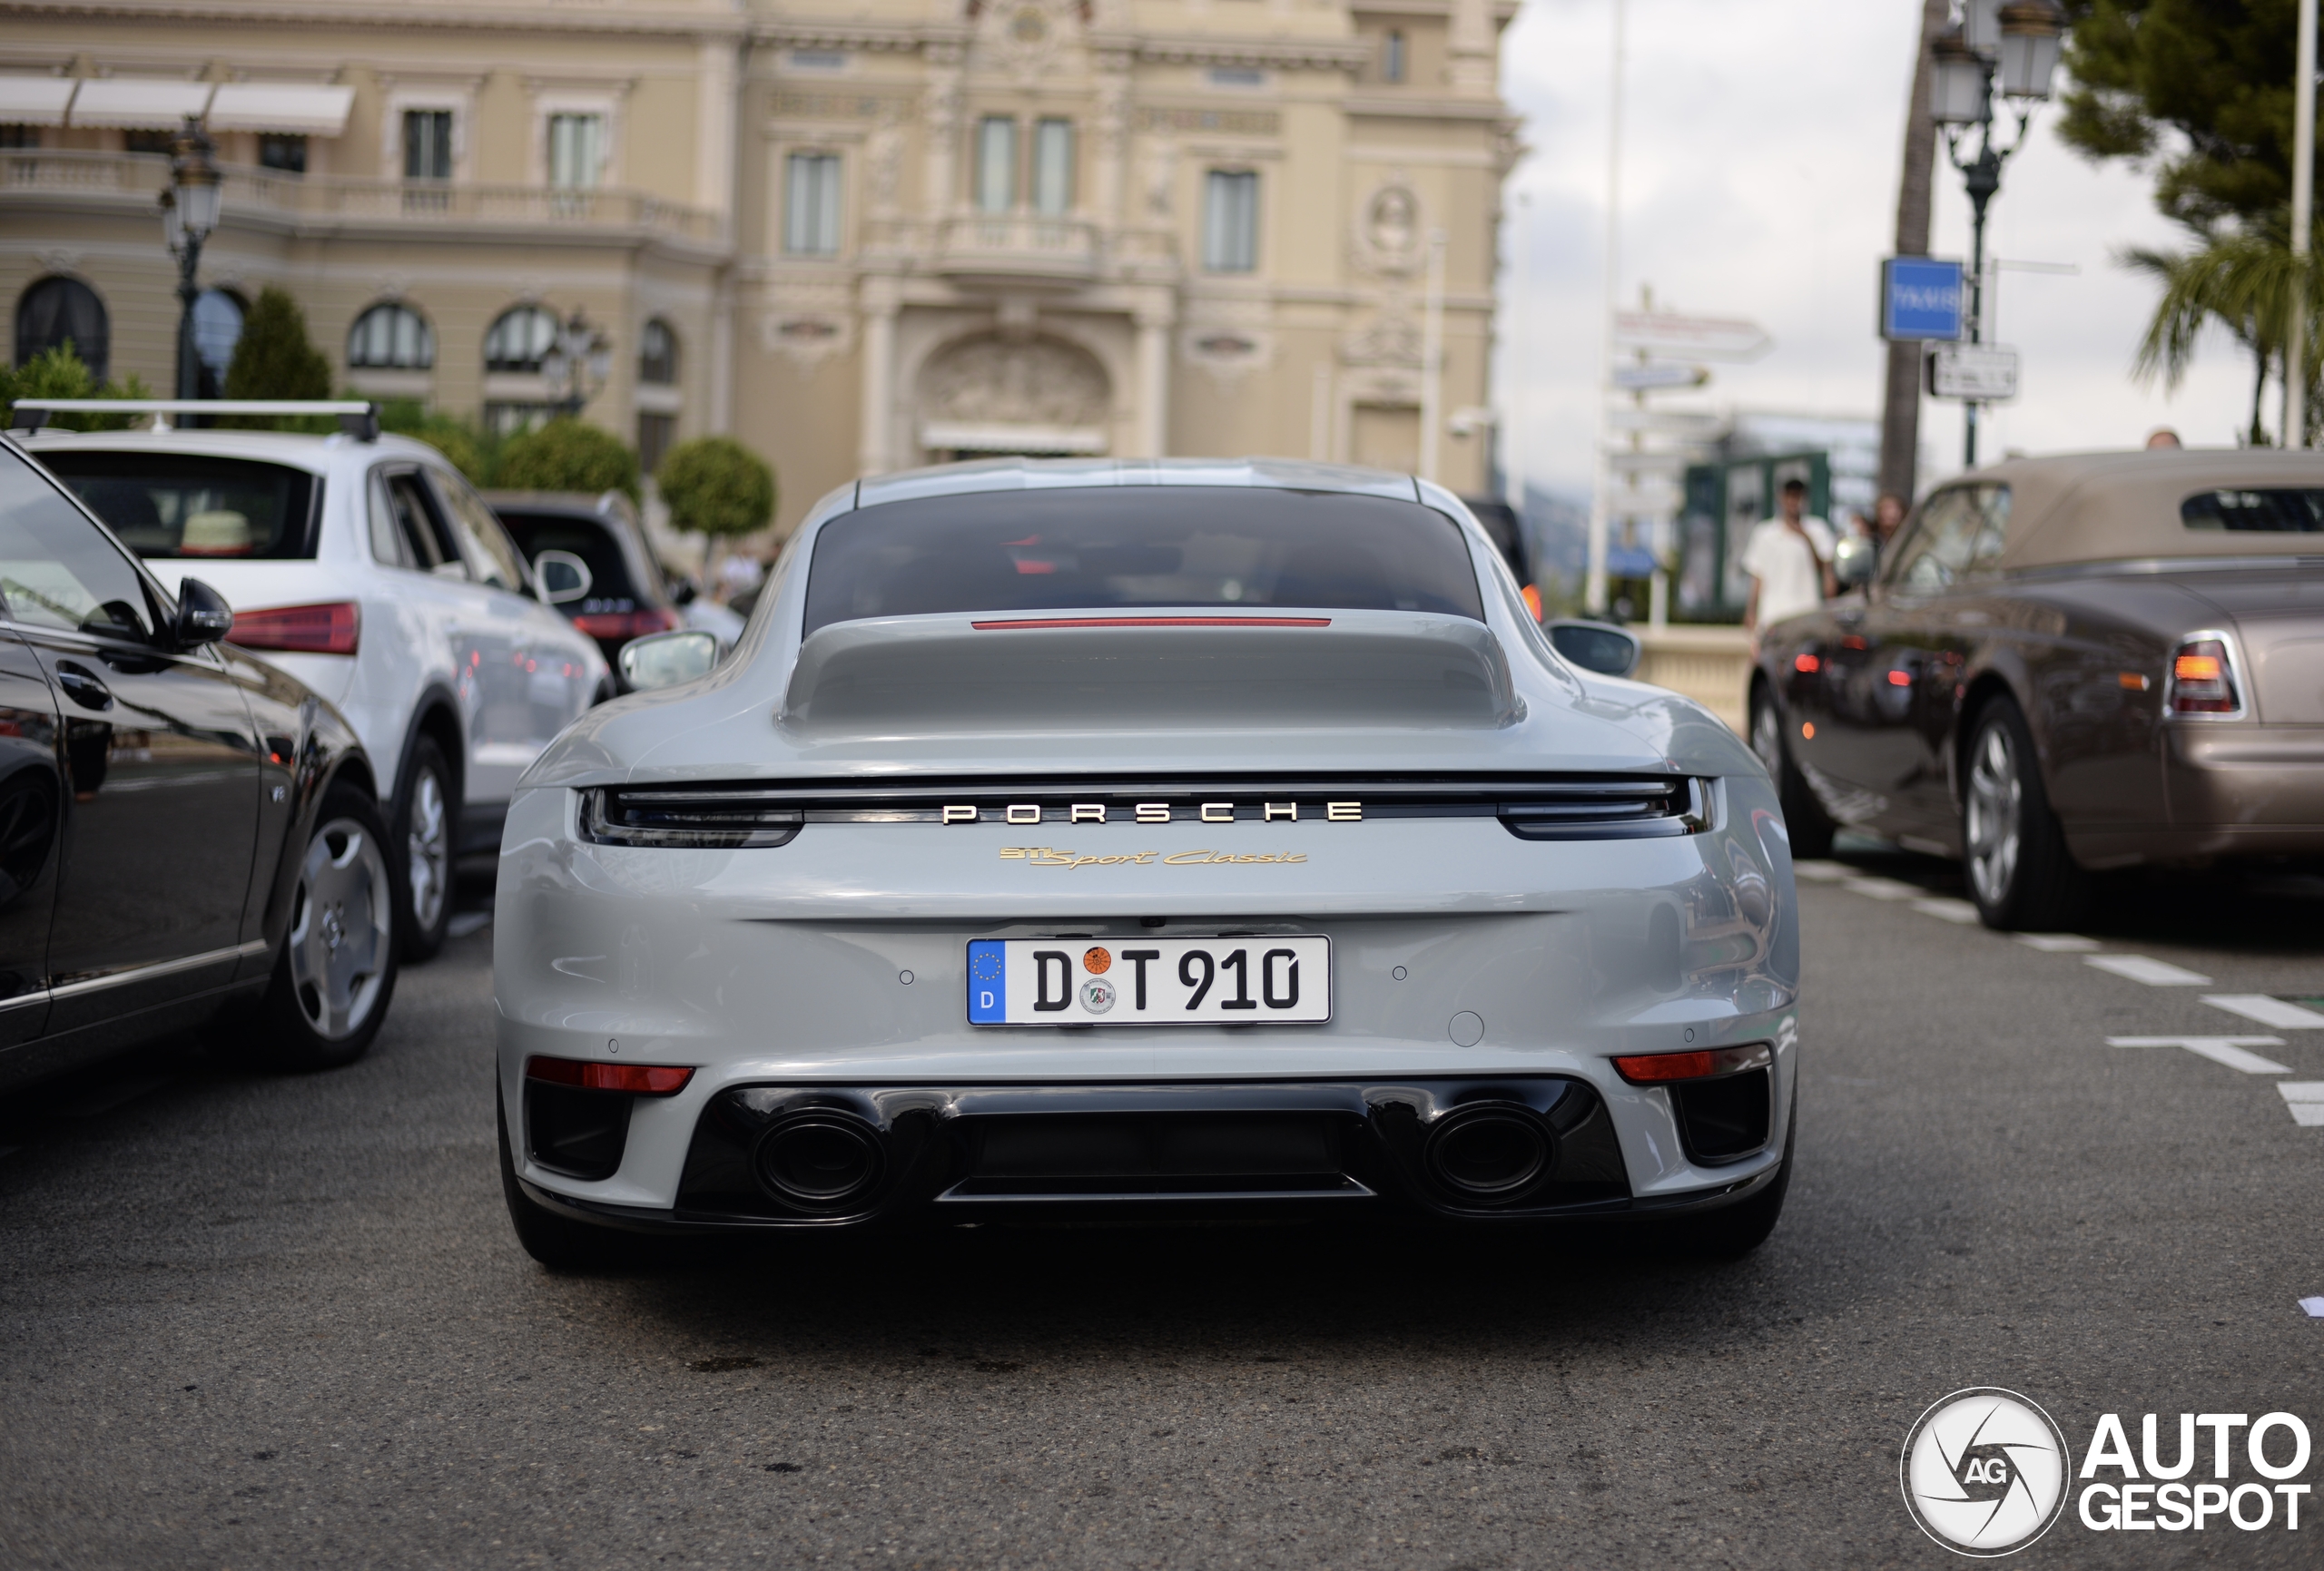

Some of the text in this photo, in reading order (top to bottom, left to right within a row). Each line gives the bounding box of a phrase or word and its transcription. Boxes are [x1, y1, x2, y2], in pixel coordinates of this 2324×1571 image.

[943, 802, 1362, 825] PORSCHE
[1030, 849, 1158, 869] Sport
[1163, 849, 1308, 865] Classic
[1178, 948, 1299, 1010] 910
[981, 991, 994, 1008] D
